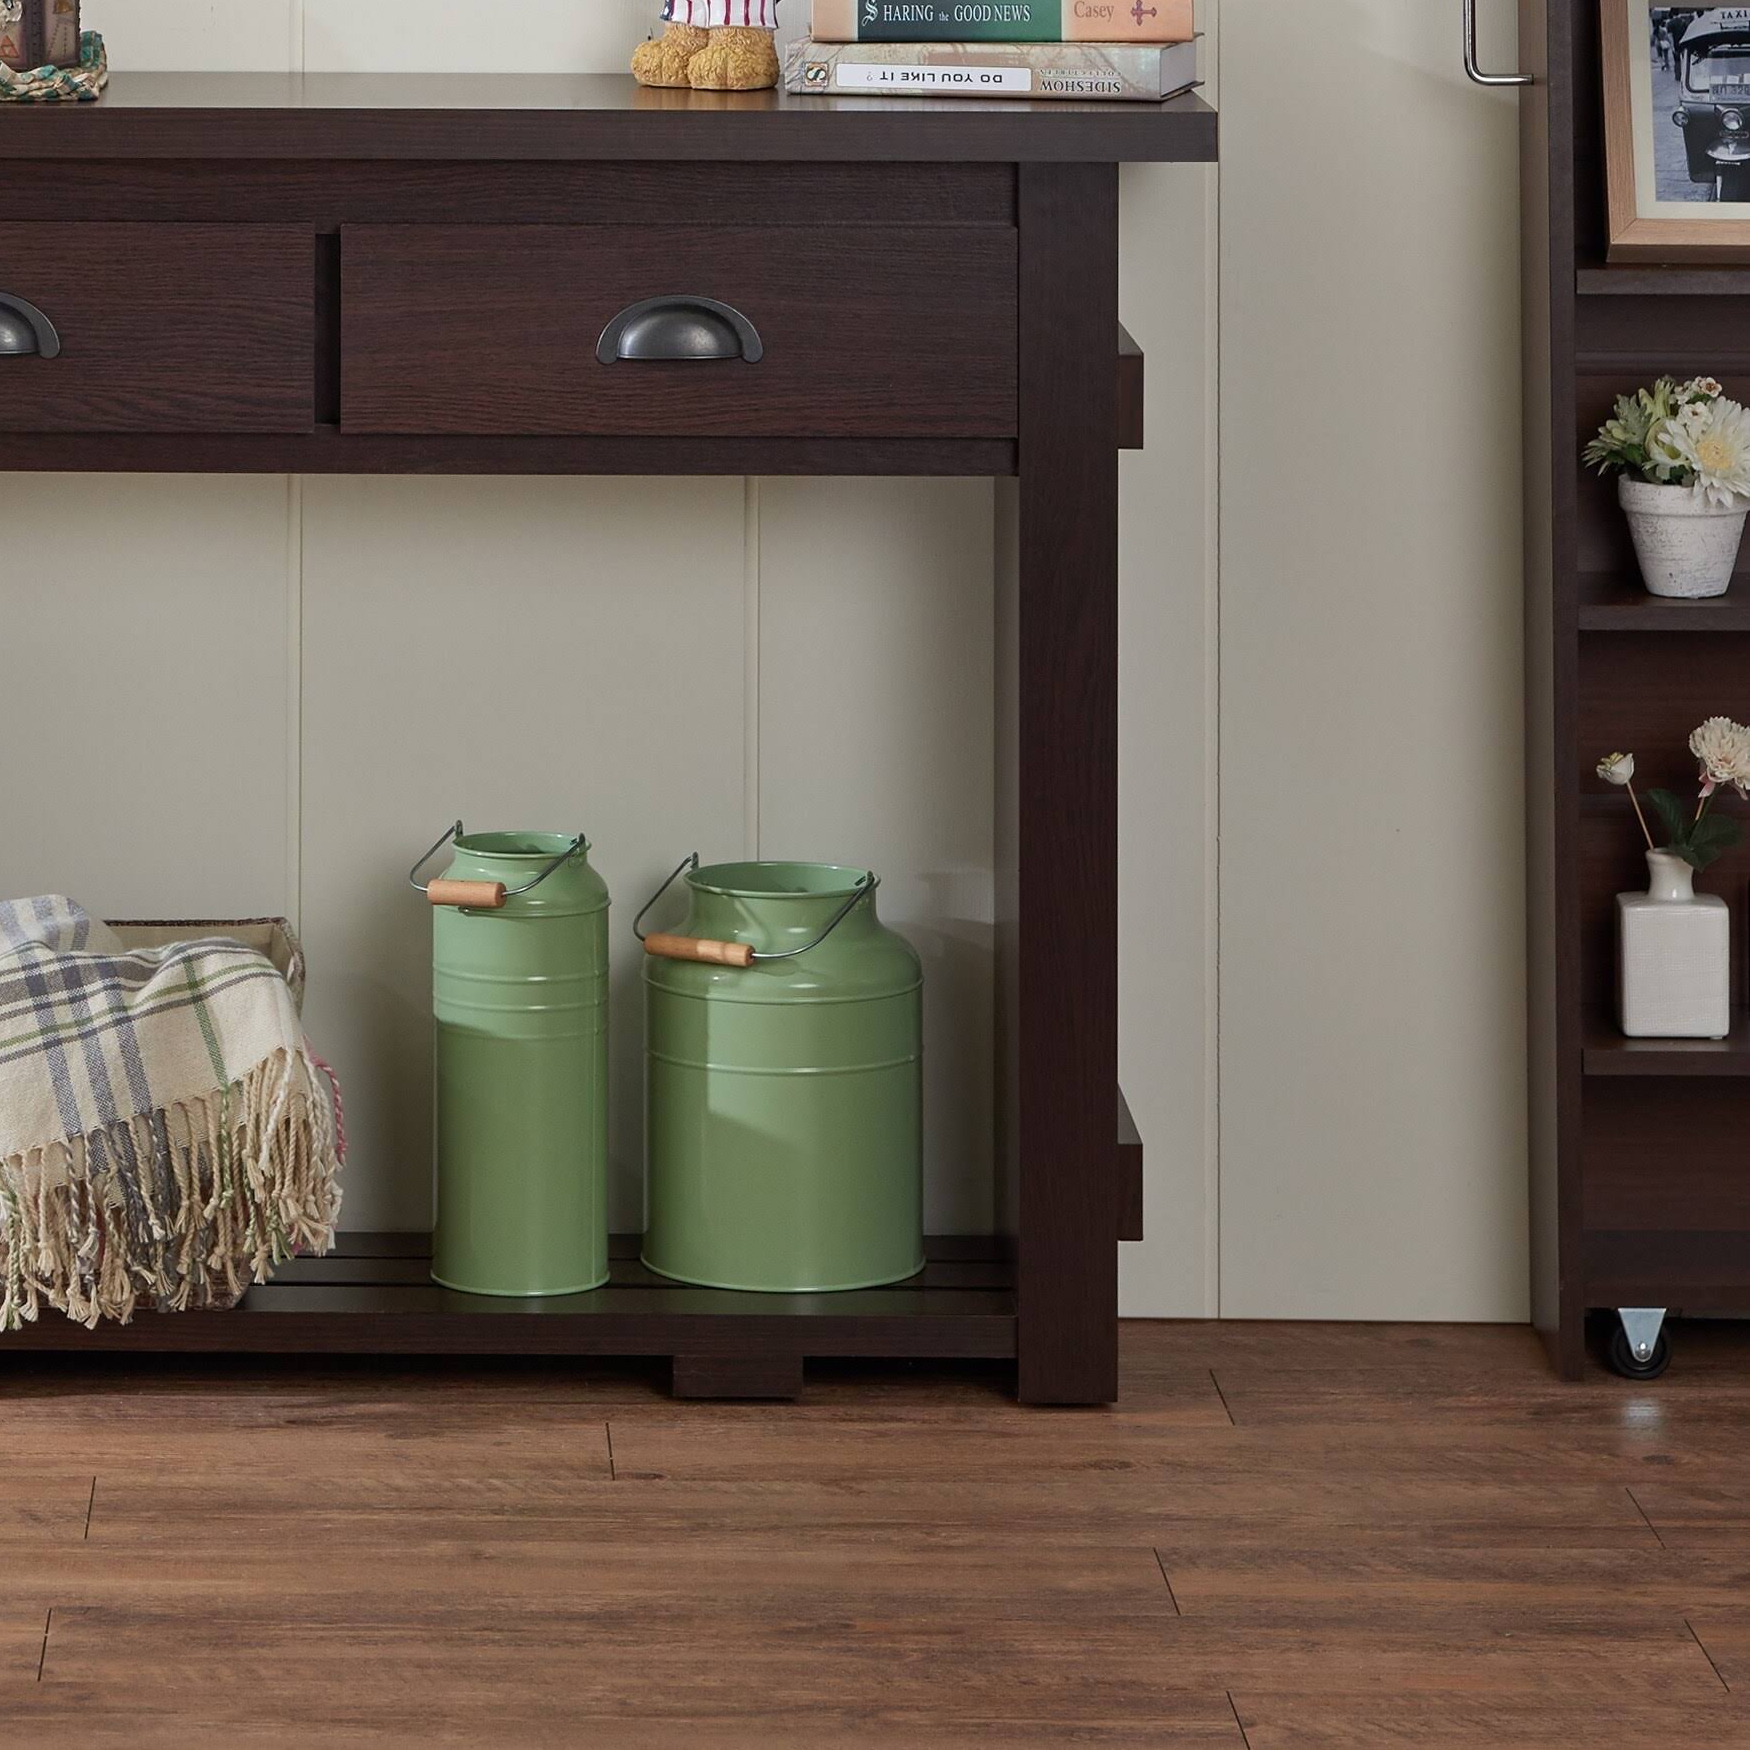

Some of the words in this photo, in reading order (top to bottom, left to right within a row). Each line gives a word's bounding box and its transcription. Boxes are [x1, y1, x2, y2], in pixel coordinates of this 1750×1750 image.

[938, 11, 950, 22] the
[954, 4, 992, 22] GOOD
[993, 4, 1032, 22] NEWS
[1073, 0, 1115, 22] Casey
[1720, 9, 1748, 19] TAXI
[880, 71, 895, 81] IT
[900, 71, 936, 82] LIKE
[941, 73, 974, 82] YOU
[980, 74, 1002, 83] DO
[1040, 80, 1121, 93] SIDESHOW
